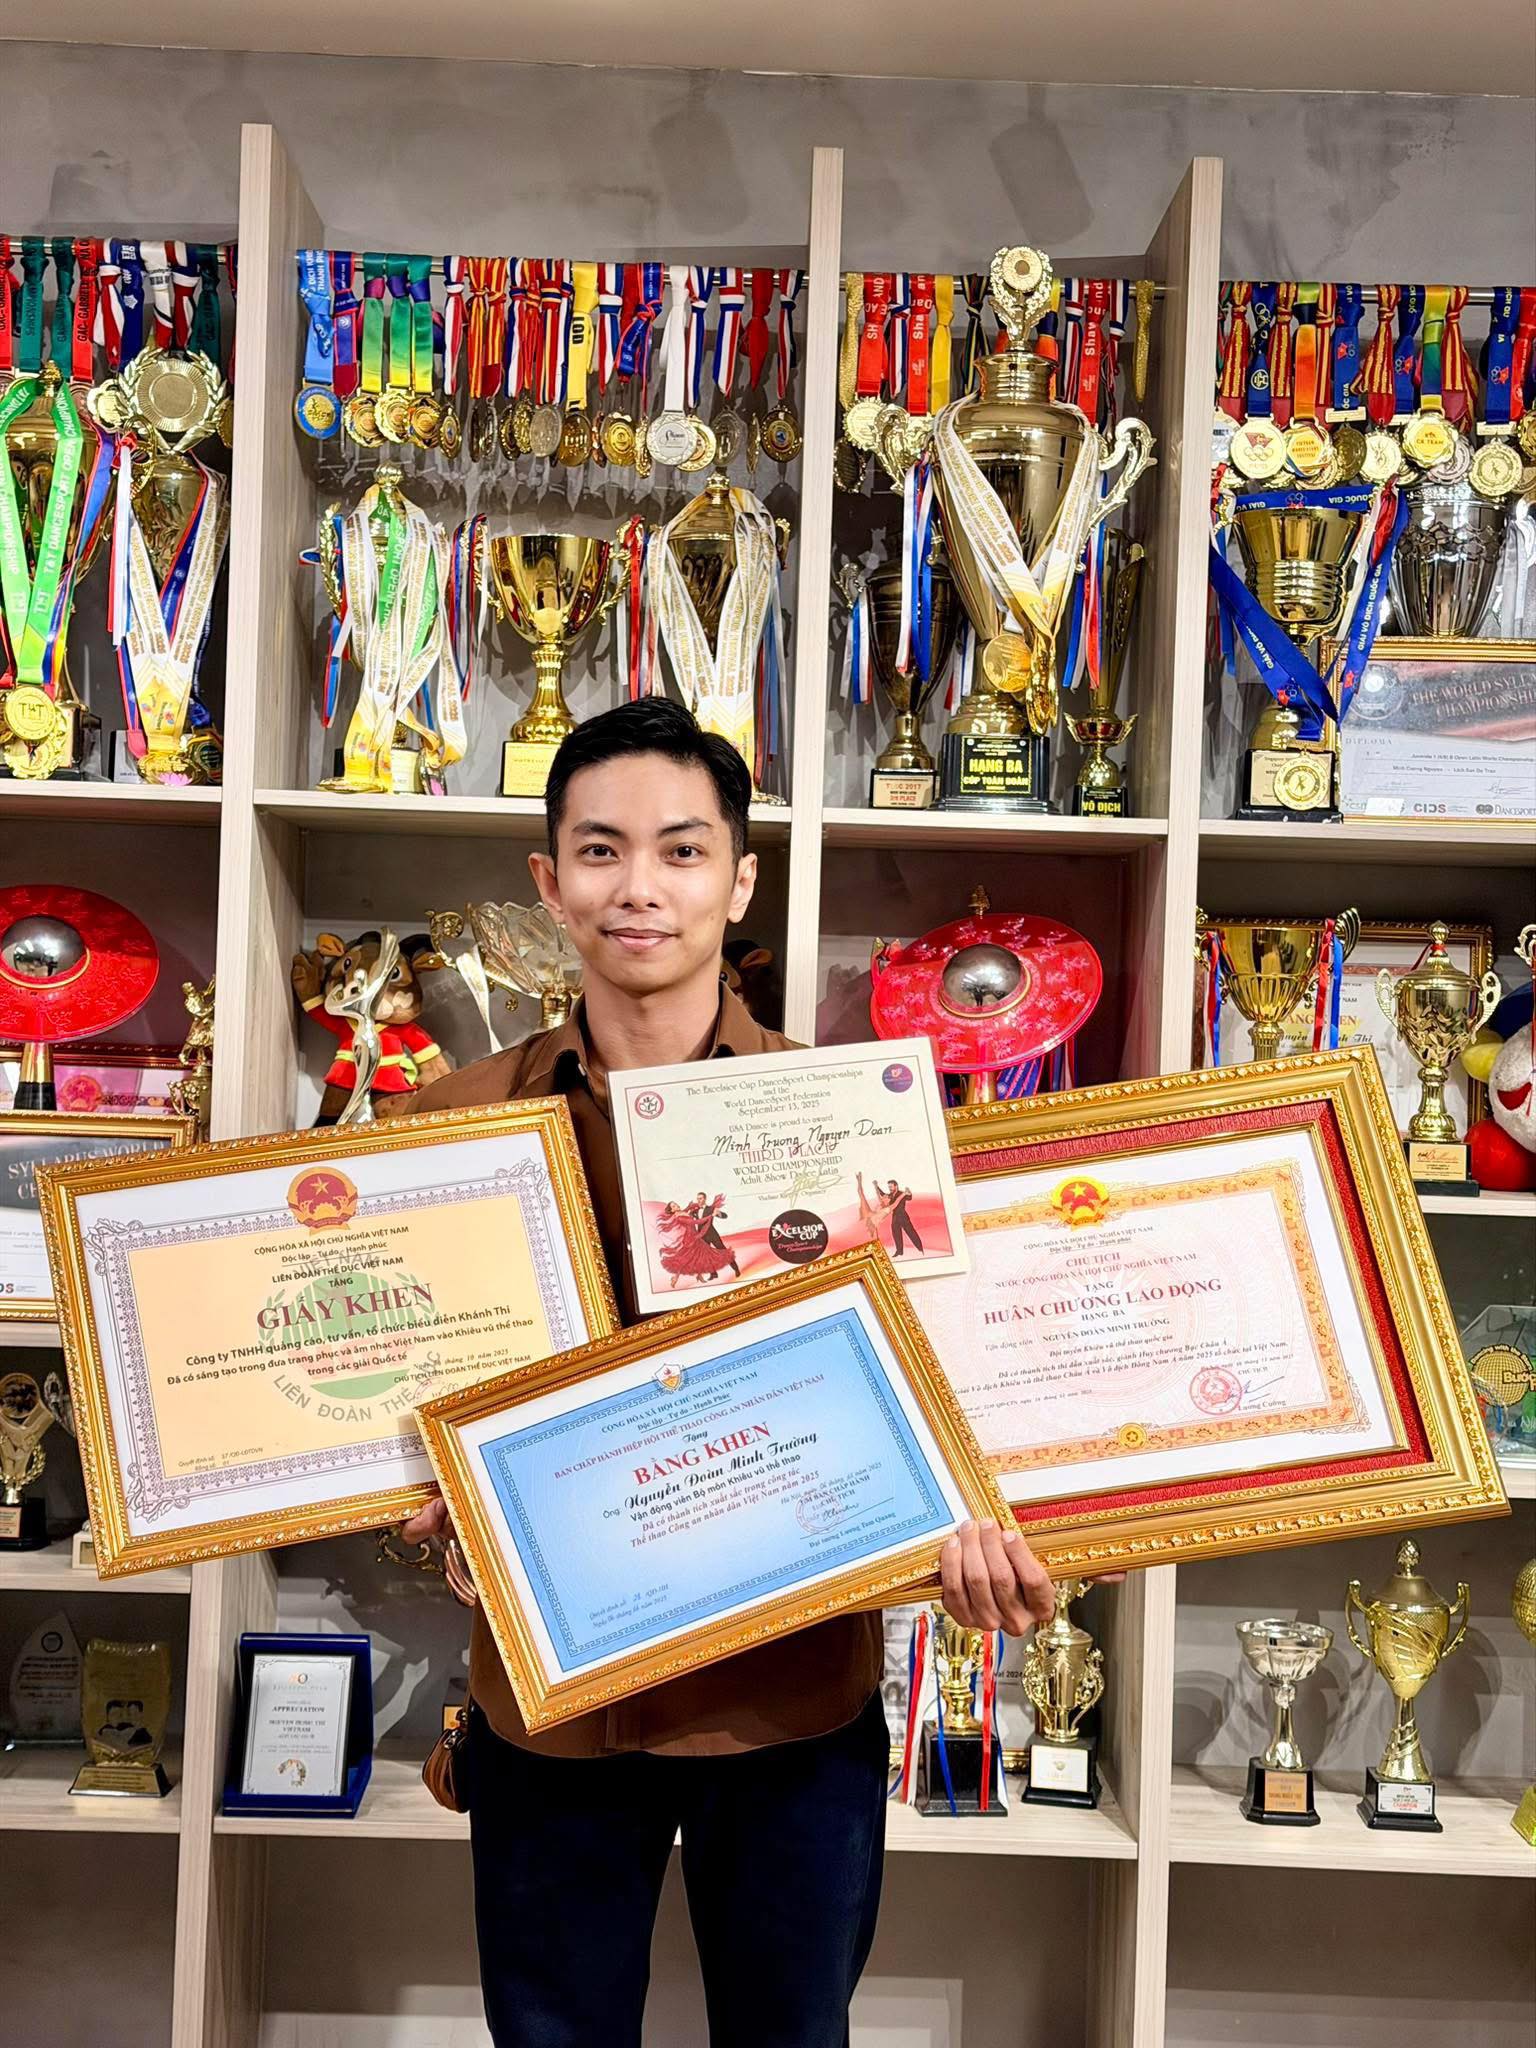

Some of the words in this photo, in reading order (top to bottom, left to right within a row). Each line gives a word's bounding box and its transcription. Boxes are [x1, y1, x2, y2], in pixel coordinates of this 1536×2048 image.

[48, 473, 71, 550] DANCESPORT
[63, 438, 77, 471] OPEN
[1439, 681, 1492, 699] WORLD
[969, 759, 1004, 775] HẠNG
[1005, 760, 1023, 774] BA
[1082, 800, 1095, 811] VÔ
[1097, 802, 1121, 814] ĐỊCH
[686, 1087, 700, 1095] The
[702, 1083, 736, 1093] Excelsior
[738, 1081, 755, 1090] Cup
[757, 1075, 803, 1086] DanceSport
[806, 1070, 862, 1081] Championships
[723, 1099, 746, 1107] World
[748, 1094, 790, 1105] DanceSport
[793, 1091, 830, 1100] Federation
[738, 1104, 783, 1117] September
[788, 1102, 799, 1110] 13,
[801, 1099, 819, 1108] 2025
[733, 1164, 769, 1175] WORLD
[772, 1155, 842, 1170] CHAMPIONSHIP
[799, 1230, 818, 1242] CUP
[272, 1273, 292, 1282] LIÊN
[293, 1268, 320, 1279] ĐOÀN
[322, 1264, 339, 1274] THỂ
[340, 1263, 359, 1273] DỤC
[360, 1259, 379, 1268] VIỆT
[382, 1256, 403, 1265] NAM
[1065, 1257, 1088, 1266] CHỦ
[1094, 1252, 1120, 1263] TỊCH
[328, 1277, 353, 1287] TẶNG
[1085, 1281, 1113, 1291] TẶNG
[257, 1298, 334, 1329] GIẤY
[345, 1283, 431, 1316] KHEN
[984, 1305, 1034, 1323] HUÂN
[1040, 1295, 1119, 1315] CHƯƠNG
[1126, 1287, 1163, 1302] LAO
[1168, 1280, 1220, 1297] ĐỘNG
[1081, 1312, 1108, 1320] HẠNG
[186, 1355, 215, 1365] Công
[217, 1352, 228, 1362] ty
[231, 1345, 263, 1358] TNHH
[265, 1341, 301, 1354] quảng
[303, 1337, 325, 1346] cáo,
[327, 1333, 339, 1342] tư
[340, 1328, 363, 1339] vấn,
[366, 1324, 377, 1335] tổ
[380, 1322, 404, 1333] chức
[406, 1318, 430, 1329] biểu
[433, 1313, 456, 1325] diễn
[458, 1308, 492, 1320] Khánh
[493, 1305, 510, 1314] Thi
[167, 1375, 180, 1384] Đã
[182, 1373, 194, 1382] có
[196, 1370, 219, 1379] sáng
[221, 1367, 237, 1375] tạo
[238, 1363, 265, 1372] trong
[267, 1359, 285, 1367] đưa
[287, 1355, 313, 1364] trang
[315, 1350, 338, 1361] phục
[340, 1347, 351, 1355] và
[353, 1345, 367, 1353] âm
[369, 1342, 392, 1350] nhạc
[392, 1338, 411, 1346] Việt
[413, 1335, 435, 1343] Nam
[454, 1327, 481, 1336] Khiêu
[482, 1323, 494, 1331] vũ
[495, 1320, 510, 1330] thể
[512, 1319, 533, 1327] thao
[307, 1366, 333, 1375] trong
[335, 1362, 350, 1370] các
[352, 1358, 370, 1369] giải
[371, 1354, 396, 1365] Quốc
[397, 1351, 406, 1360] tế
[317, 1400, 374, 1425] ĐOÀN
[634, 1448, 699, 1484] BẰNG
[704, 1422, 769, 1458] KHEN
[602, 1508, 620, 1518] Ông
[624, 1483, 679, 1508] Nguyễn
[684, 1468, 722, 1485] Đoàn
[730, 1450, 762, 1469] Minh
[767, 1433, 816, 1454] Trường
[630, 1511, 647, 1521] Vận
[649, 1502, 672, 1514] động
[673, 1495, 691, 1505] viên
[692, 1488, 705, 1498] Bộ
[707, 1481, 726, 1493] môn
[727, 1472, 752, 1485] Khiêu
[753, 1466, 765, 1475] vũ
[765, 1459, 780, 1470] thể
[781, 1454, 800, 1465] thao
